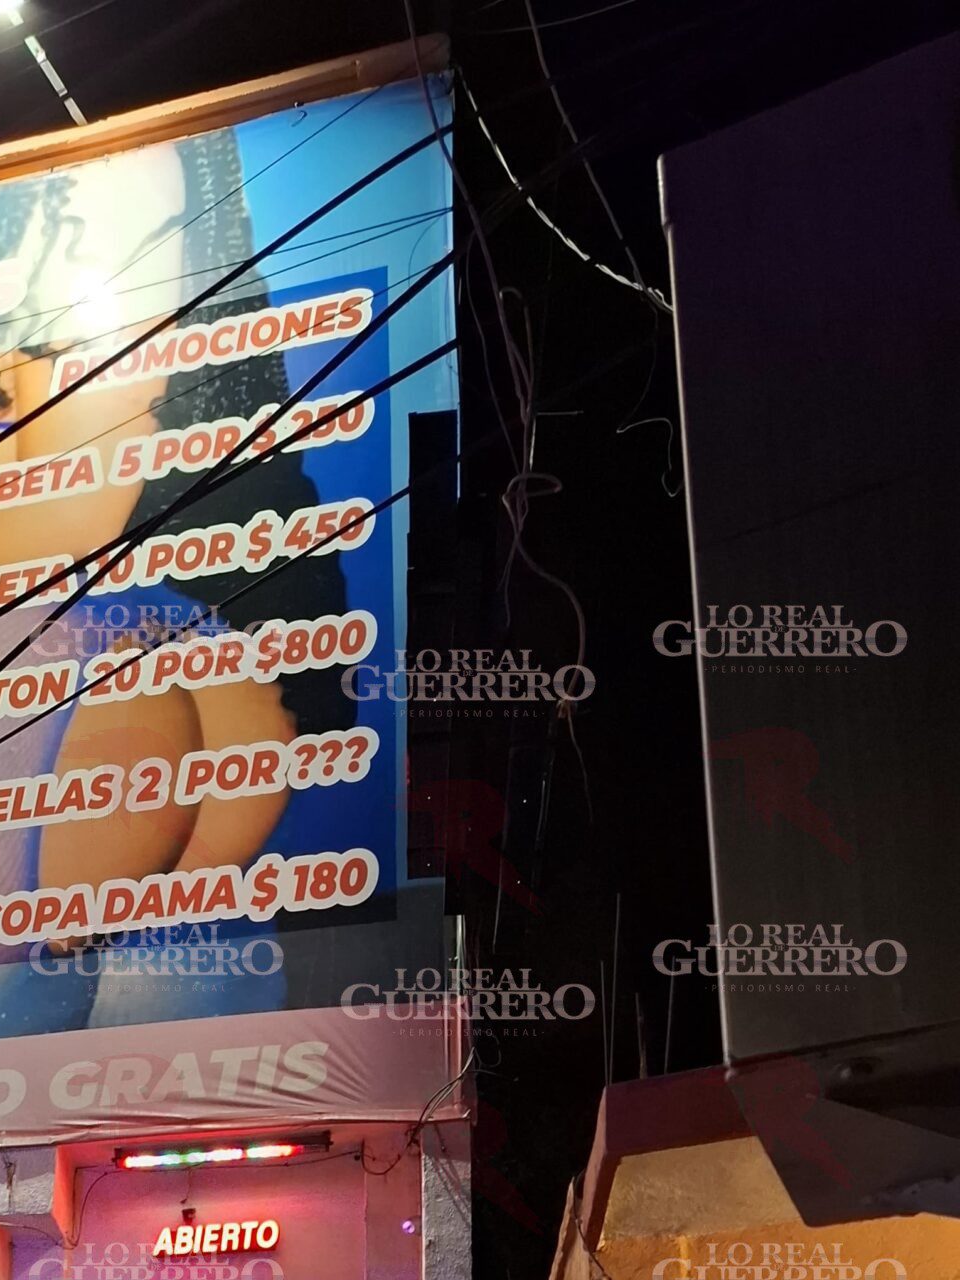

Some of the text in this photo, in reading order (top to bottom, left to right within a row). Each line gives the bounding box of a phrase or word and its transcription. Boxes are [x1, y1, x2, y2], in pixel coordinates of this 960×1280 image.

[60, 296, 365, 388] PROMOCIONES
[118, 444, 143, 478] 5
[152, 425, 241, 472] POR
[145, 532, 236, 578] POR
[246, 519, 273, 564] $
[284, 506, 366, 550] 450
[94, 660, 141, 695] 20
[153, 642, 243, 687] POR
[255, 618, 367, 674] $800
[136, 766, 162, 803] 2
[184, 751, 281, 796] POR
[293, 736, 369, 781] ???
[102, 873, 238, 924] DAMA
[249, 863, 280, 912] $
[294, 858, 369, 902] 180
[49, 1042, 329, 1107] GRATIS
[154, 1220, 280, 1257] ABIERTO
